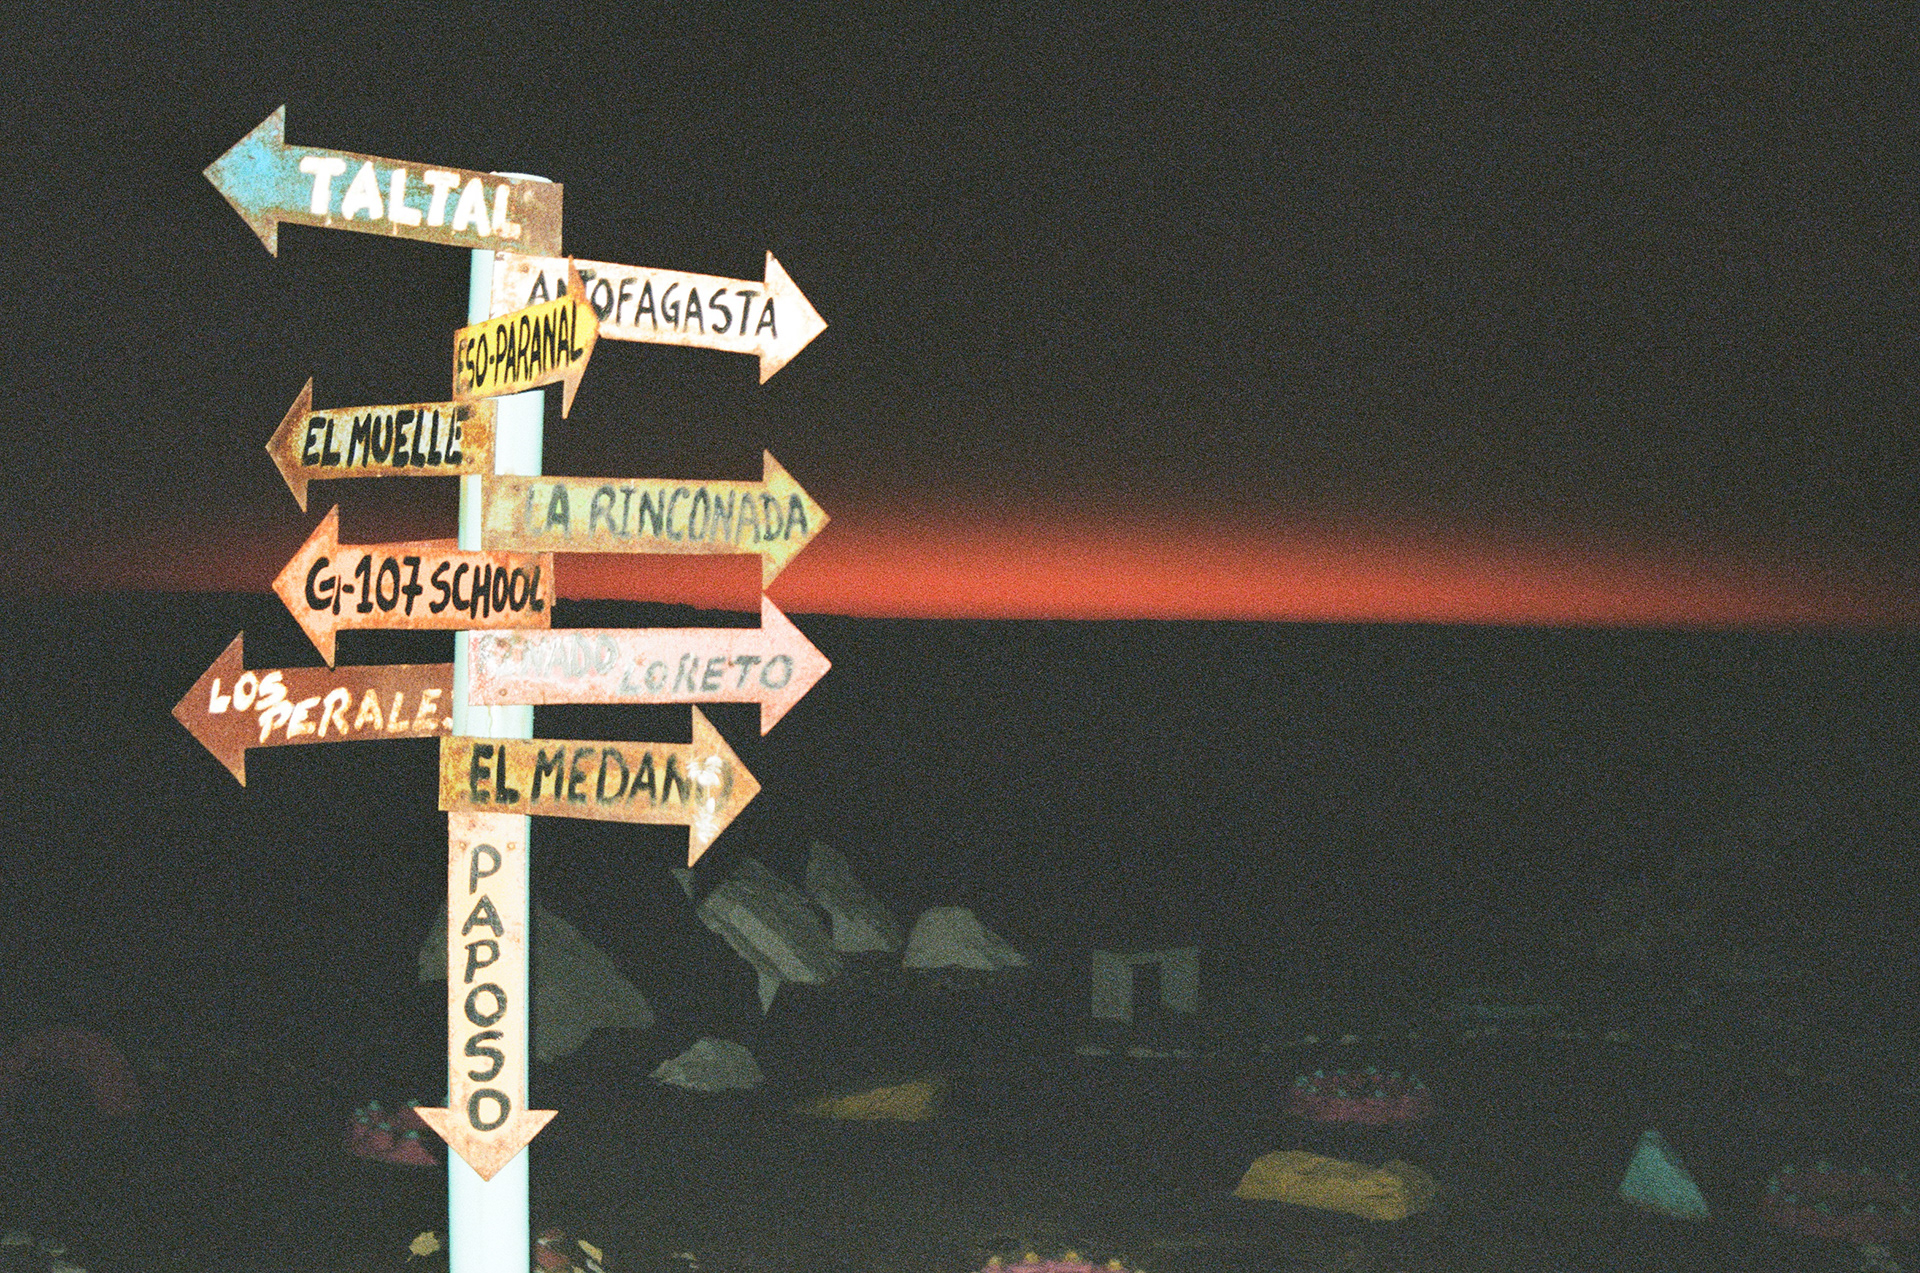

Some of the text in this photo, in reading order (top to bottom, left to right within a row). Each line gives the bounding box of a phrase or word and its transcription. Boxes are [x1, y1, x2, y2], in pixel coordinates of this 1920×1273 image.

[299, 156, 521, 241] TALTAL
[301, 405, 471, 468] EL MUELLE
[524, 483, 809, 544] LA RINCONADA
[304, 554, 545, 620] G-107 SCHOOL
[208, 670, 289, 714] LOS
[617, 654, 796, 697] LORETO
[258, 686, 454, 744] PERALE
[469, 742, 522, 805] EL
[461, 843, 511, 1132] PAPOSO
